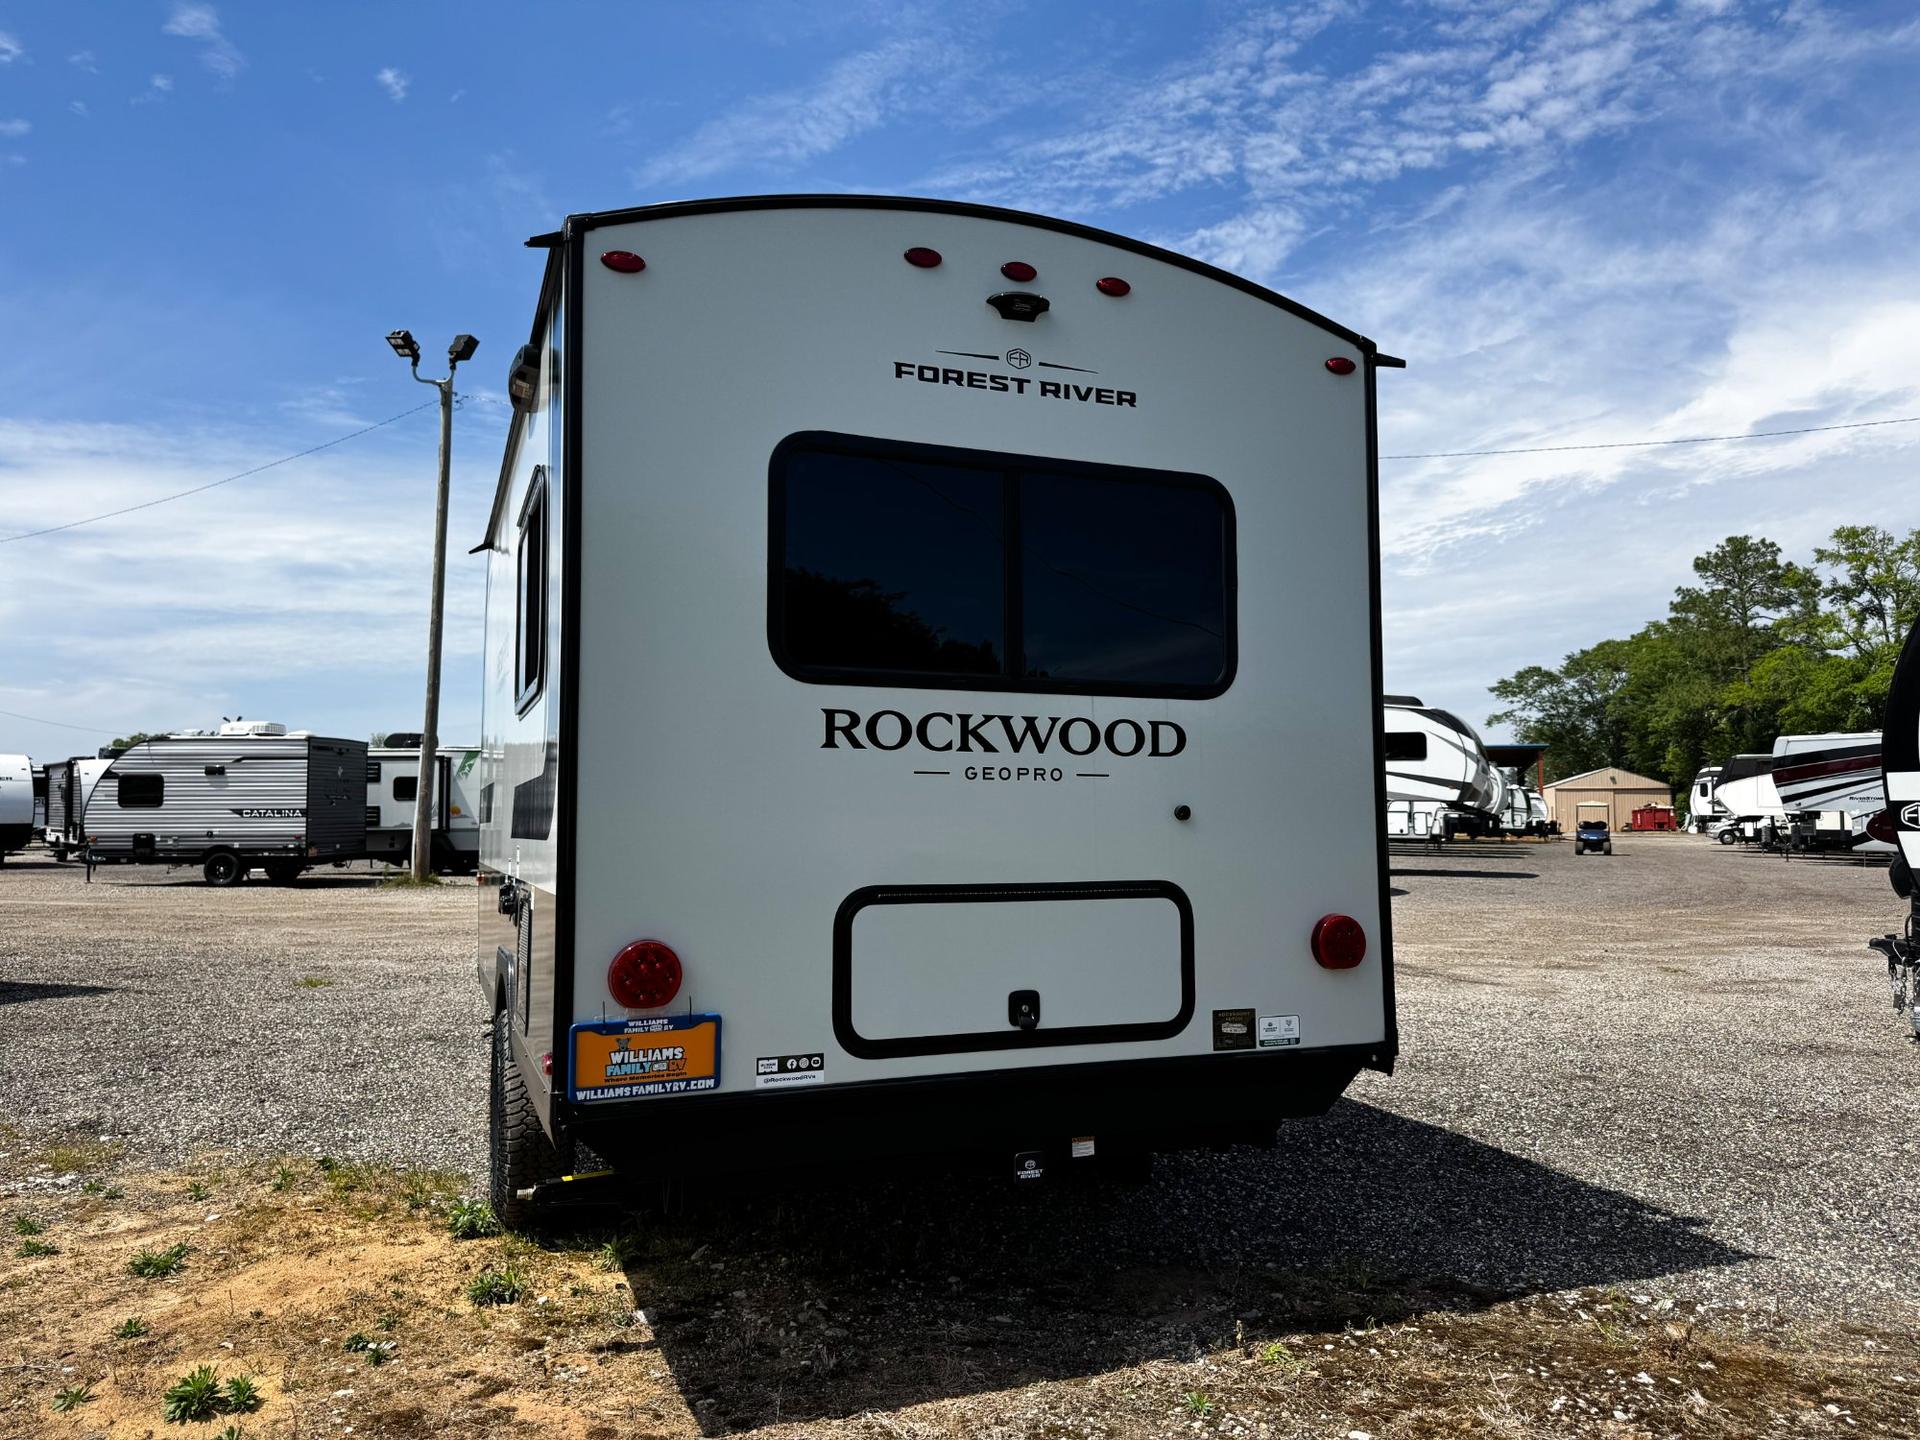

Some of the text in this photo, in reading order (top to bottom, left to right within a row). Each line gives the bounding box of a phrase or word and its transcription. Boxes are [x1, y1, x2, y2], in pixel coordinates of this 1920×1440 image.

[894, 361, 1137, 408] FOREST RIVER
[820, 708, 1188, 757] ROCKWOOD
[964, 766, 1064, 782] GEOPRO
[242, 809, 303, 818] CATALINA
[624, 1026, 649, 1034] FAMILY
[628, 1018, 668, 1027] WILLIAMS
[610, 1047, 684, 1064] WILLIAMS
[606, 1061, 652, 1077] FAMILY
[668, 1058, 687, 1071] RV
